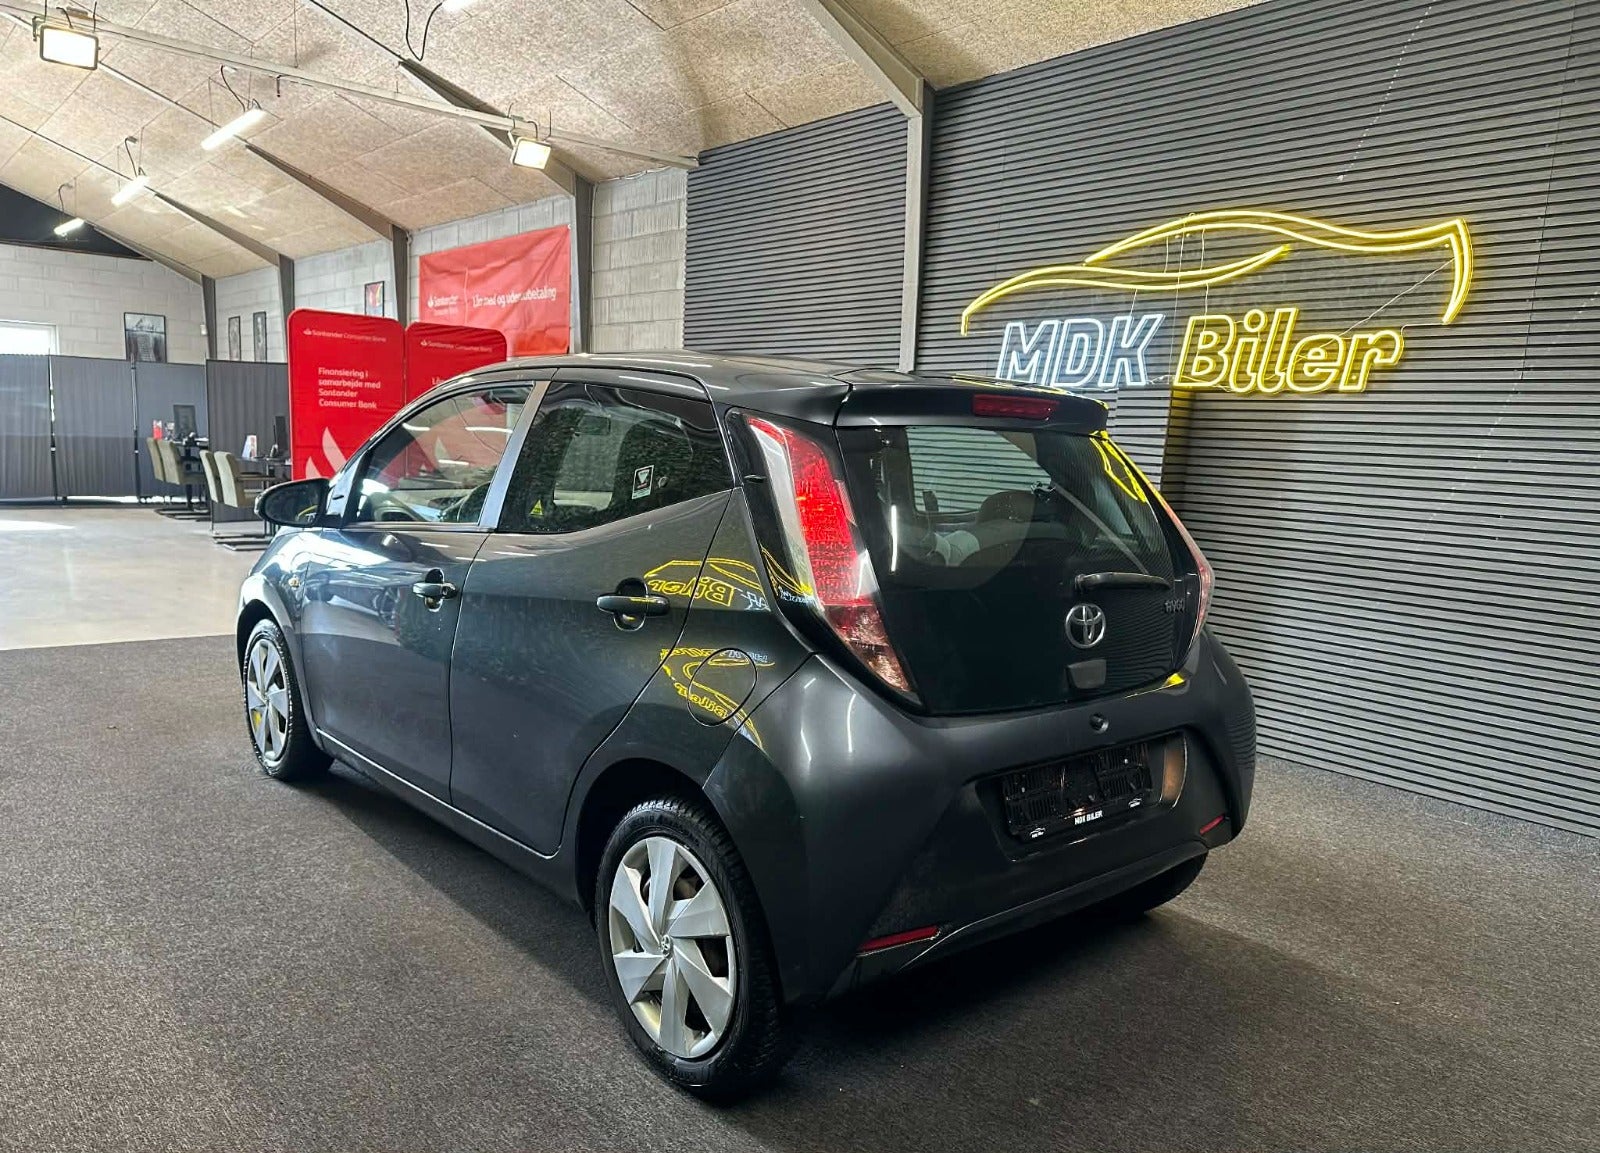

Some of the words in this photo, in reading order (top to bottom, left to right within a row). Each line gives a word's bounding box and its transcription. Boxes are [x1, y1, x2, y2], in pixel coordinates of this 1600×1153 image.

[996, 314, 1166, 388] MDK
[1173, 307, 1405, 394] Biler
[318, 367, 364, 379] Finansiering
[318, 379, 362, 389] samarbejde
[364, 381, 381, 389] med
[318, 388, 358, 398] Santander
[318, 398, 357, 408] Consumer
[358, 400, 377, 409] Bank
[1086, 810, 1103, 822] BILER
